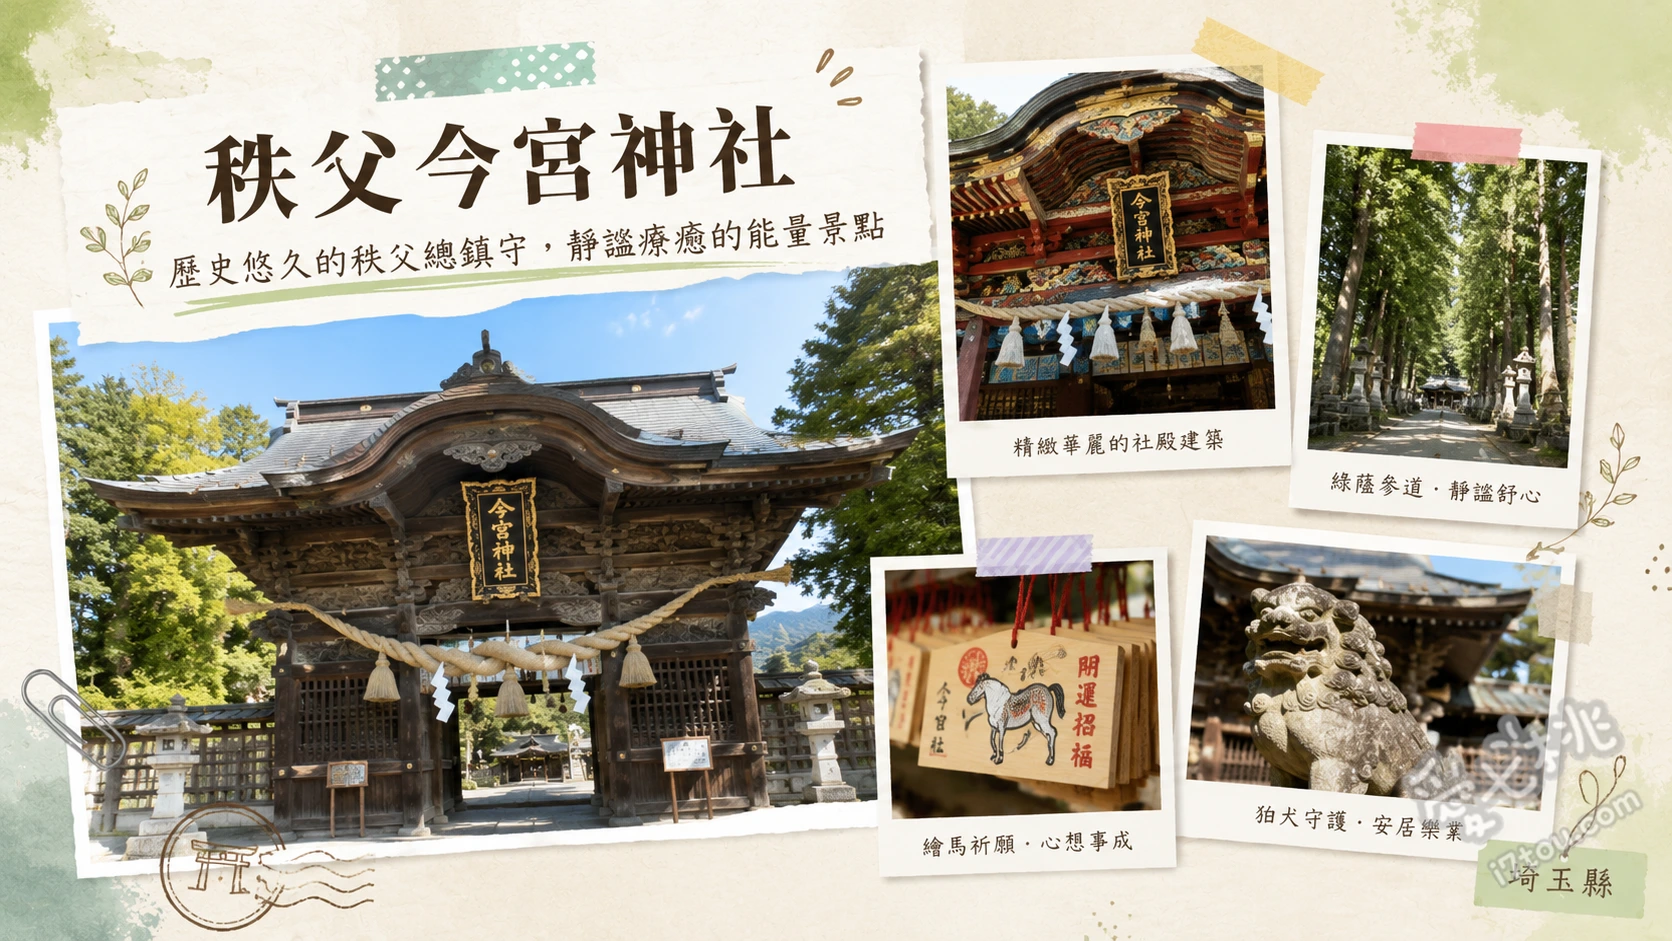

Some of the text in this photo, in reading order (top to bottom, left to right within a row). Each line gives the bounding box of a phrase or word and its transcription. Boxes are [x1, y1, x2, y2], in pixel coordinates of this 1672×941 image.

[1130, 191, 1156, 261] 今宮神社
[487, 497, 518, 582] 今宮神社
